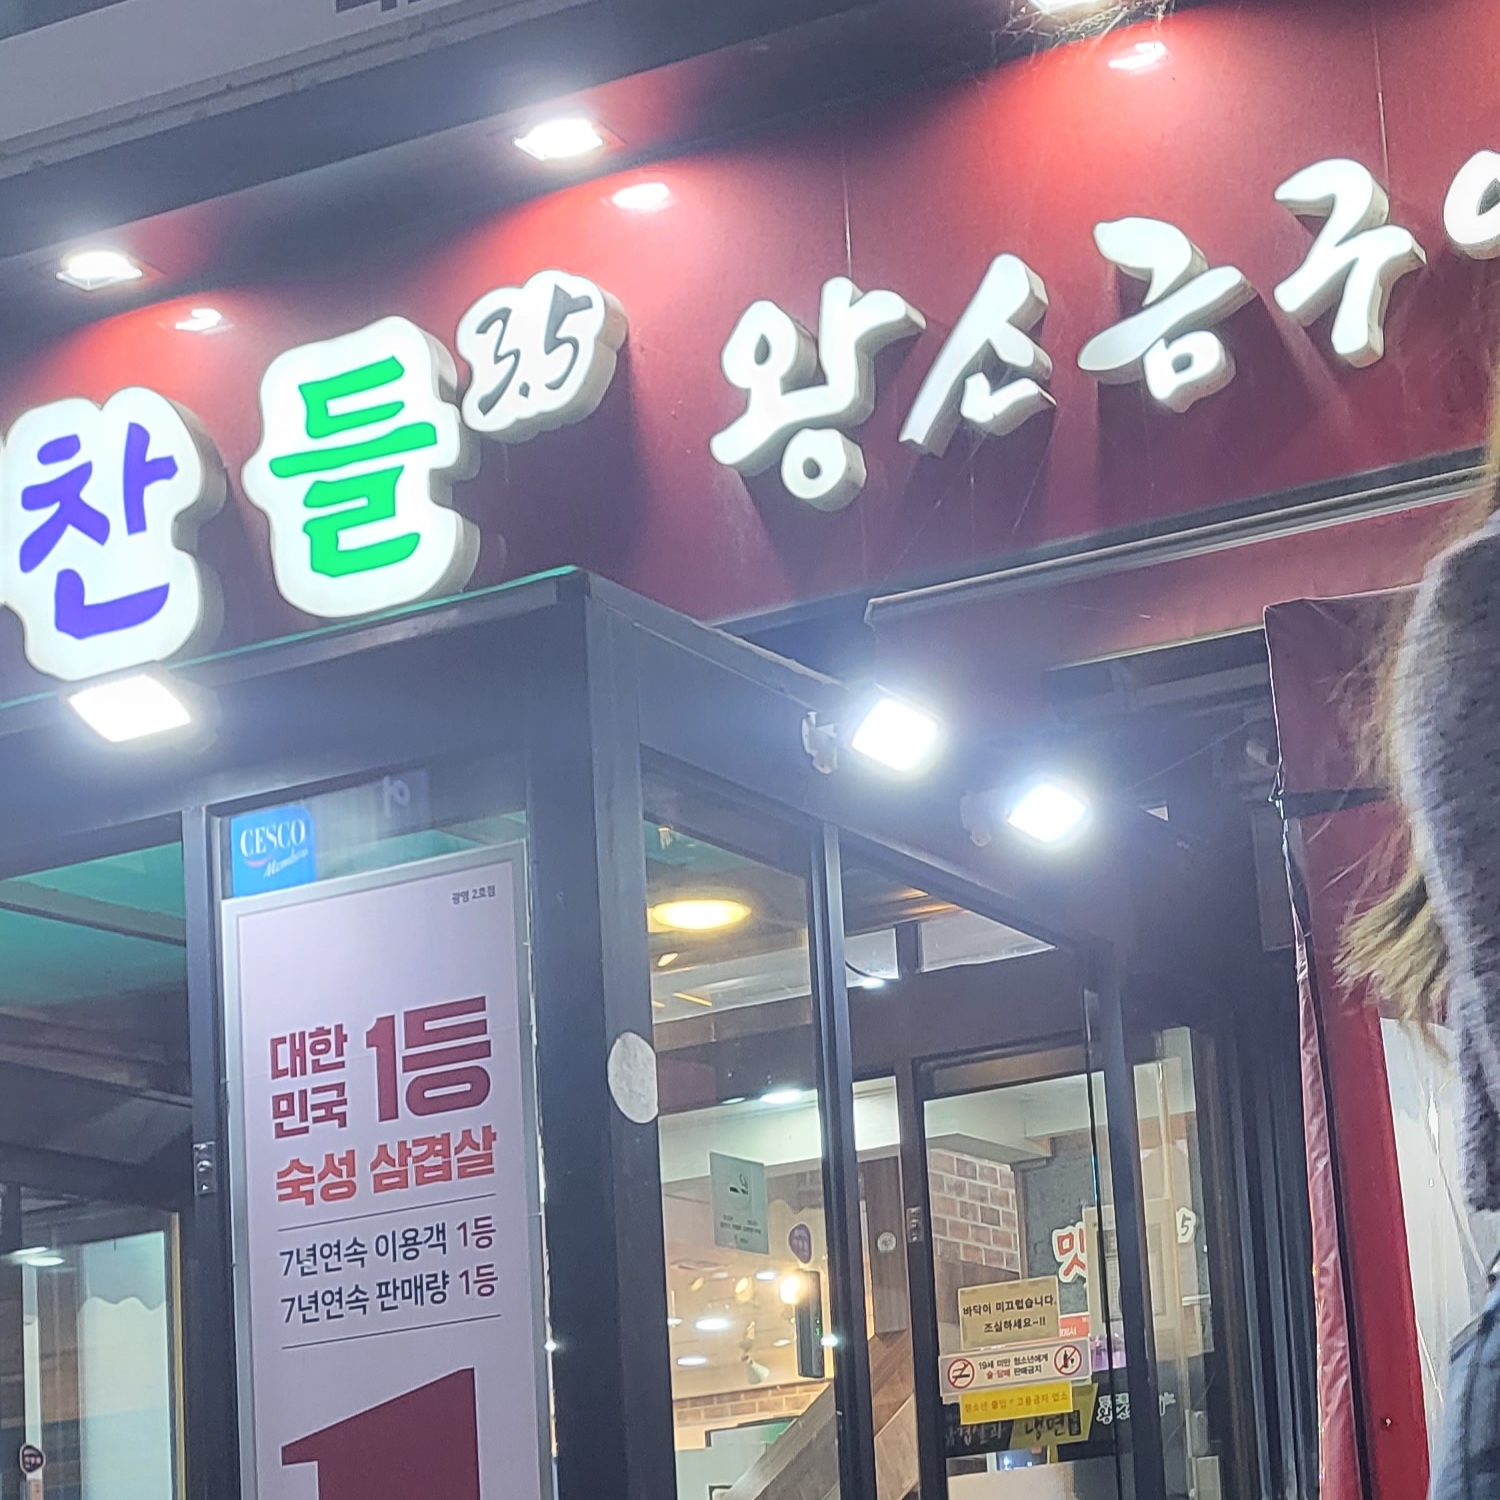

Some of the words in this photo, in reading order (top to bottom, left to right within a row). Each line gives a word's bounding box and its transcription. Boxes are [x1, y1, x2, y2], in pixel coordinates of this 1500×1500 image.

[476, 284, 593, 417] 3.5
[239, 819, 306, 857] CESCO
[471, 885, 496, 900] 2호점
[270, 1023, 348, 1080] 대한
[365, 996, 492, 1122] 1등
[271, 1081, 348, 1139] 민국
[276, 1149, 357, 1206] 숙성
[370, 1125, 497, 1194] 삼겹살
[279, 1236, 368, 1277] 7년연속
[375, 1222, 447, 1263] 이용객
[456, 1216, 497, 1250] 1등
[281, 1284, 370, 1324] 7년연속
[375, 1270, 450, 1312] 판매량
[459, 1264, 499, 1297] 1등
[963, 1303, 992, 1317] 바닥이
[978, 1361, 994, 1370] 19세
[996, 1358, 1011, 1367] 미만
[1013, 1353, 1048, 1365] 청소년에게
[1014, 1365, 1042, 1376] 판매금지
